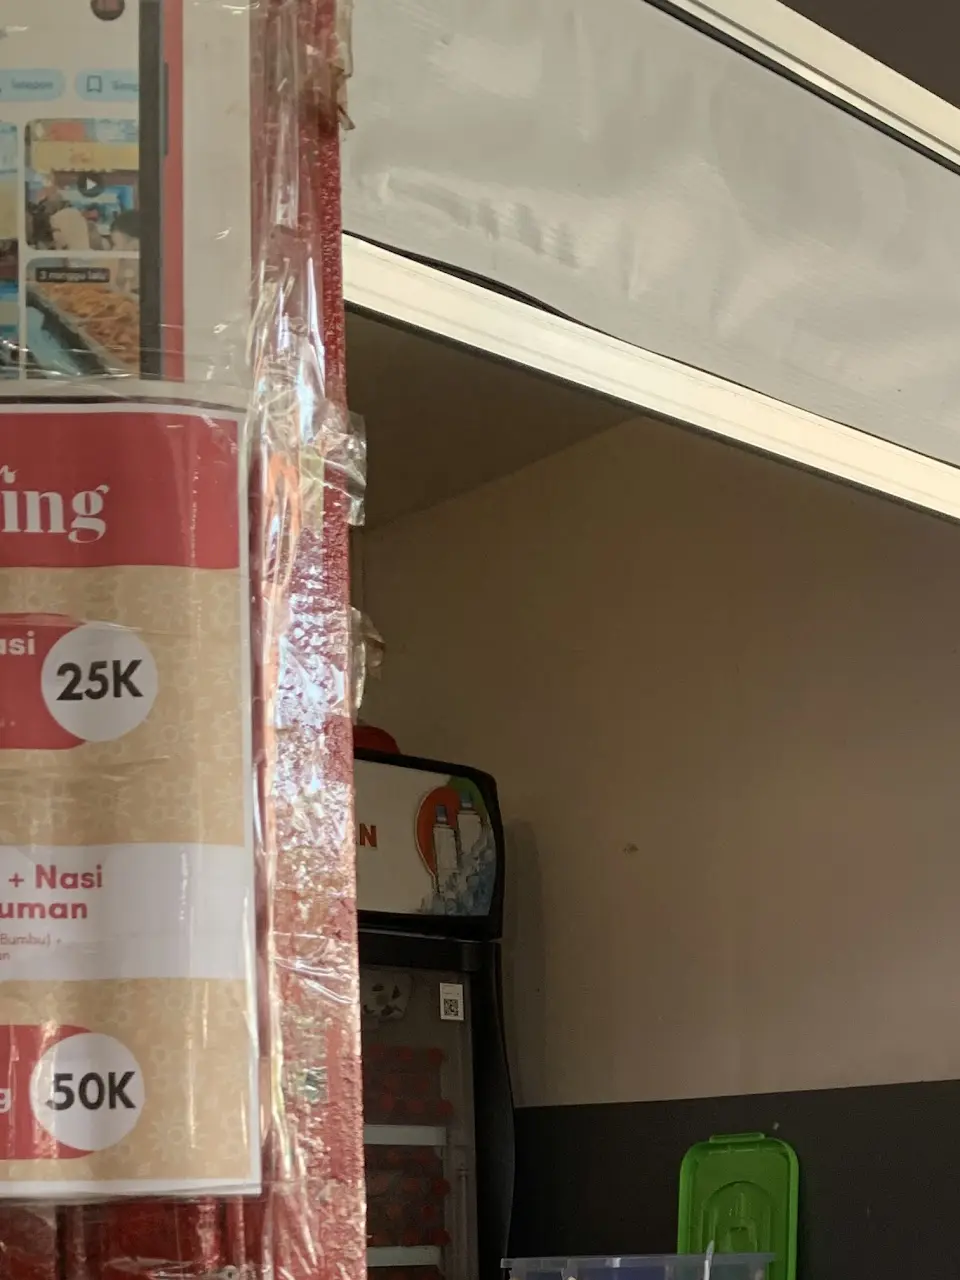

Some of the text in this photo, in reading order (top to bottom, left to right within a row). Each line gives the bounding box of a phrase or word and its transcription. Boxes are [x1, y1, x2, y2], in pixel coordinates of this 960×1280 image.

[56, 659, 144, 701] 25K
[35, 864, 102, 889] Nasi
[46, 1071, 136, 1111] 50K
